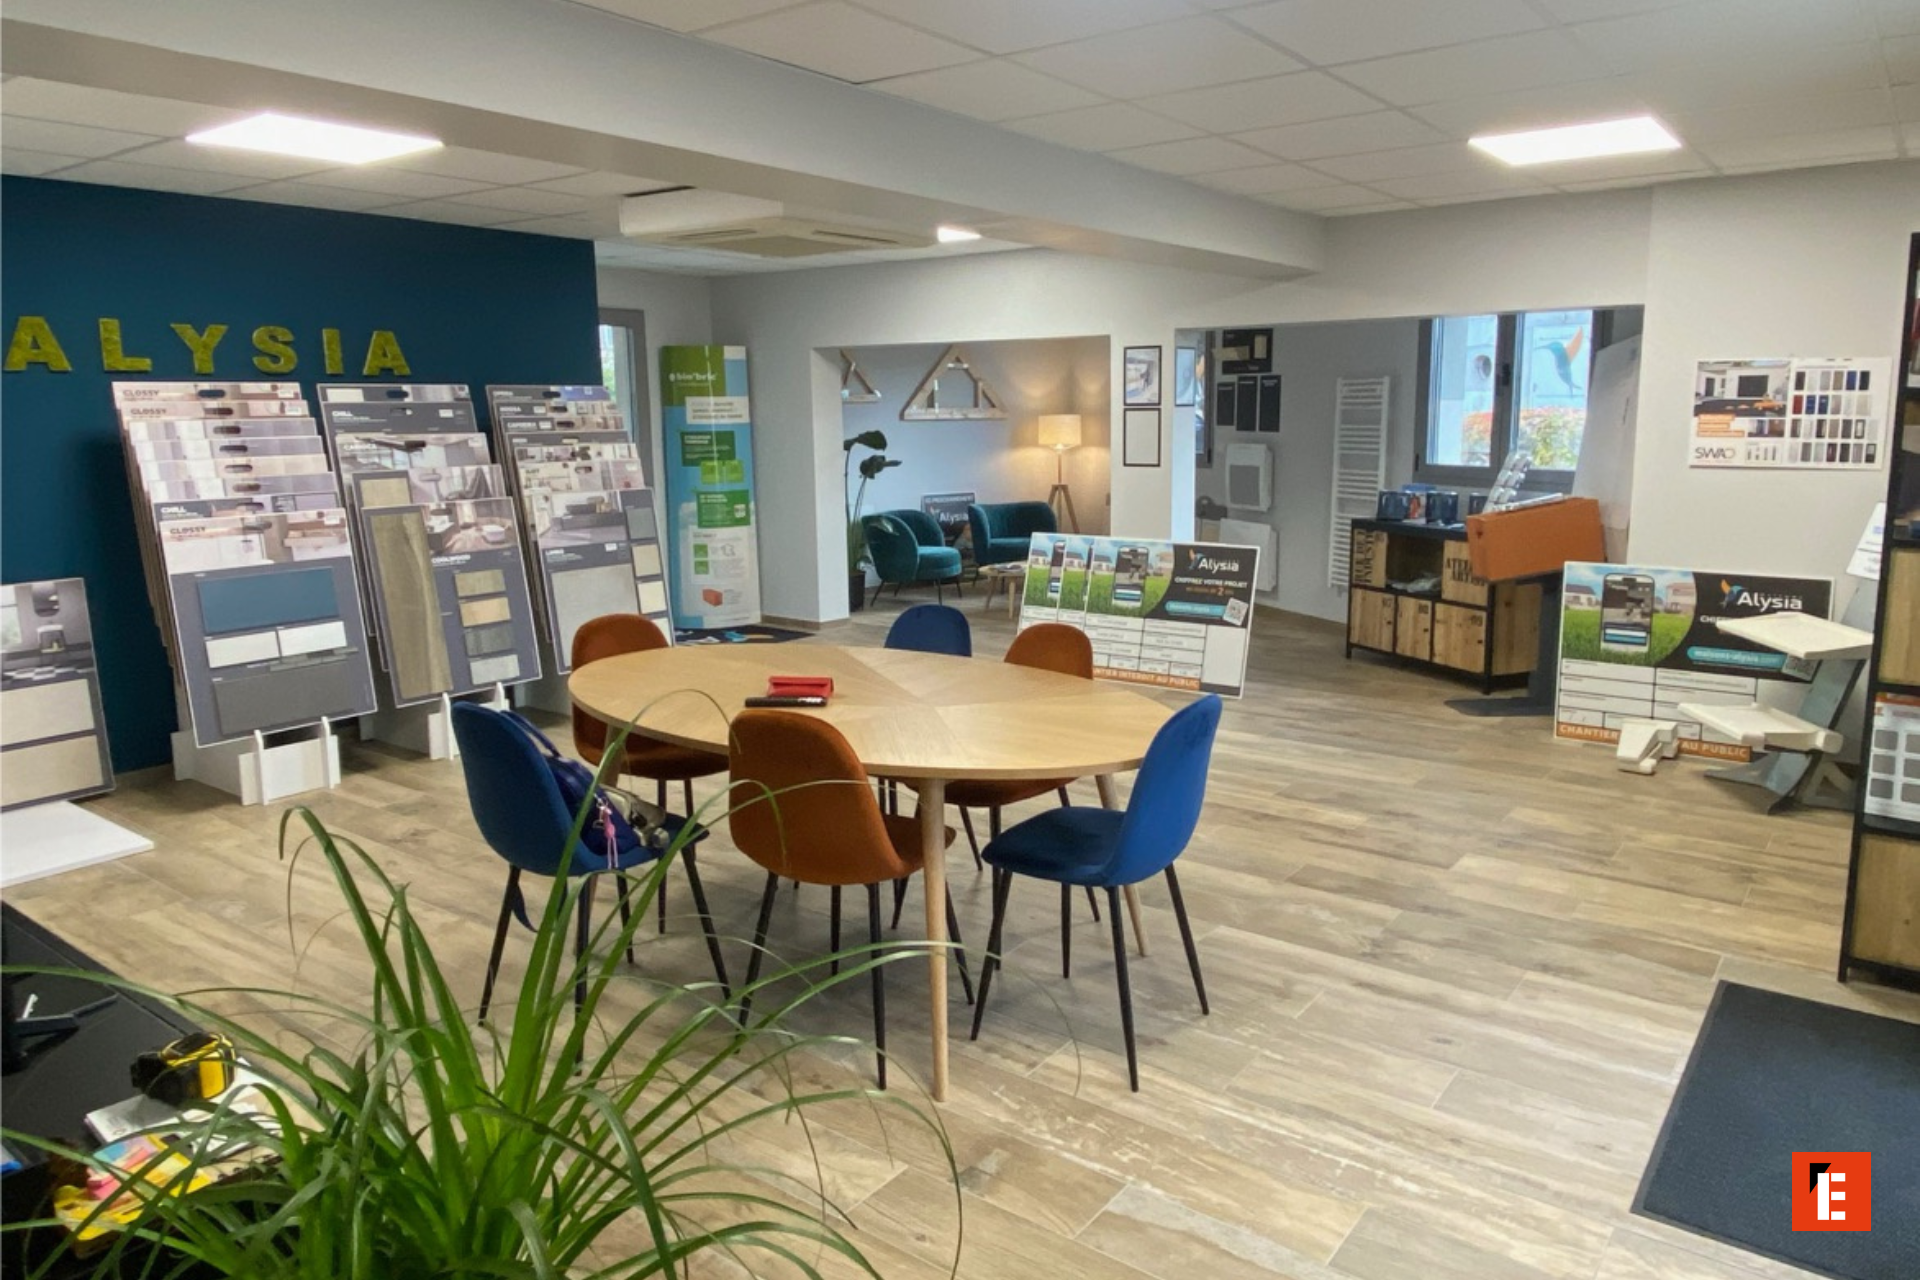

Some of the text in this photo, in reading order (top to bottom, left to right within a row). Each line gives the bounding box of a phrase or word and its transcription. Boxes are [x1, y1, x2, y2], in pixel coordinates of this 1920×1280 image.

[4, 315, 411, 376] ALYSIA
[939, 512, 969, 526] Alysia
[1198, 558, 1239, 574] Alysia
[1736, 592, 1803, 612] Alysia
[1169, 677, 1200, 688] PUBLIC
[1559, 726, 1748, 757] CHANTIER AU PUBLIC
